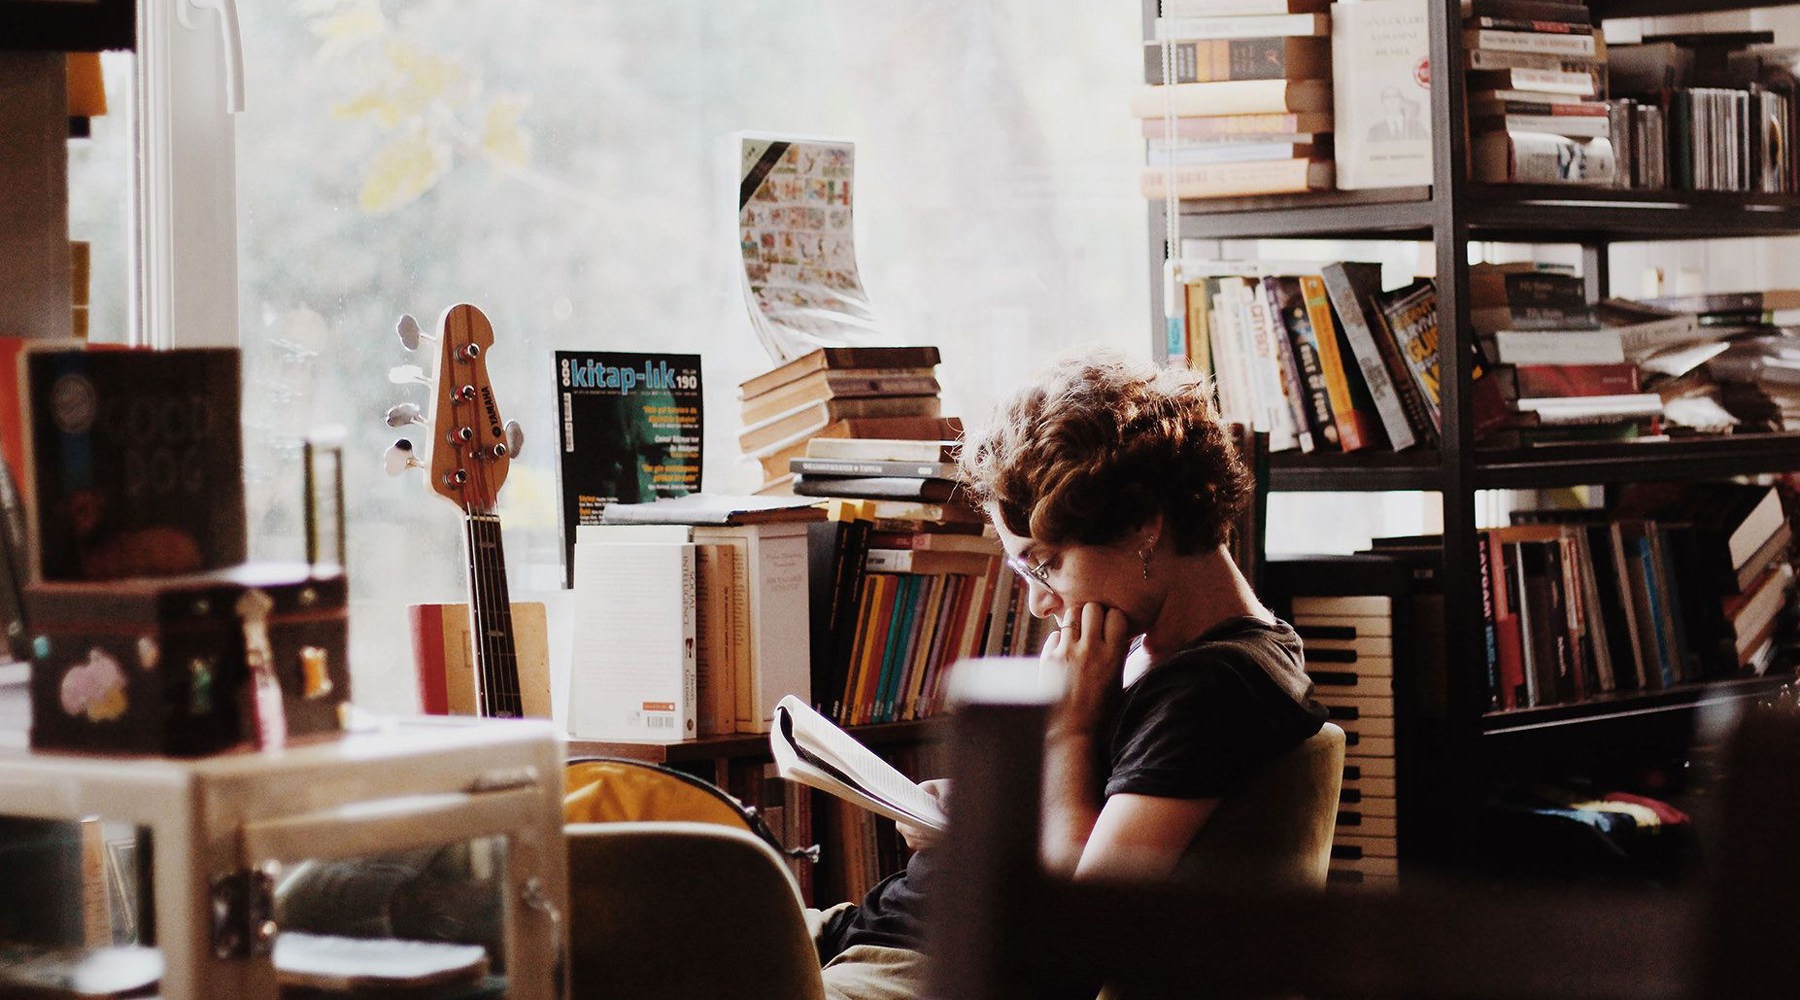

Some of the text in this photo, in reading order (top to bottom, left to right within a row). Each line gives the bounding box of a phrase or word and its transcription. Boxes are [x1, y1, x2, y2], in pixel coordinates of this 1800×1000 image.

[571, 359, 676, 395] kitap-lık
[676, 376, 697, 389] 190
[481, 387, 497, 425] YAMAHA
